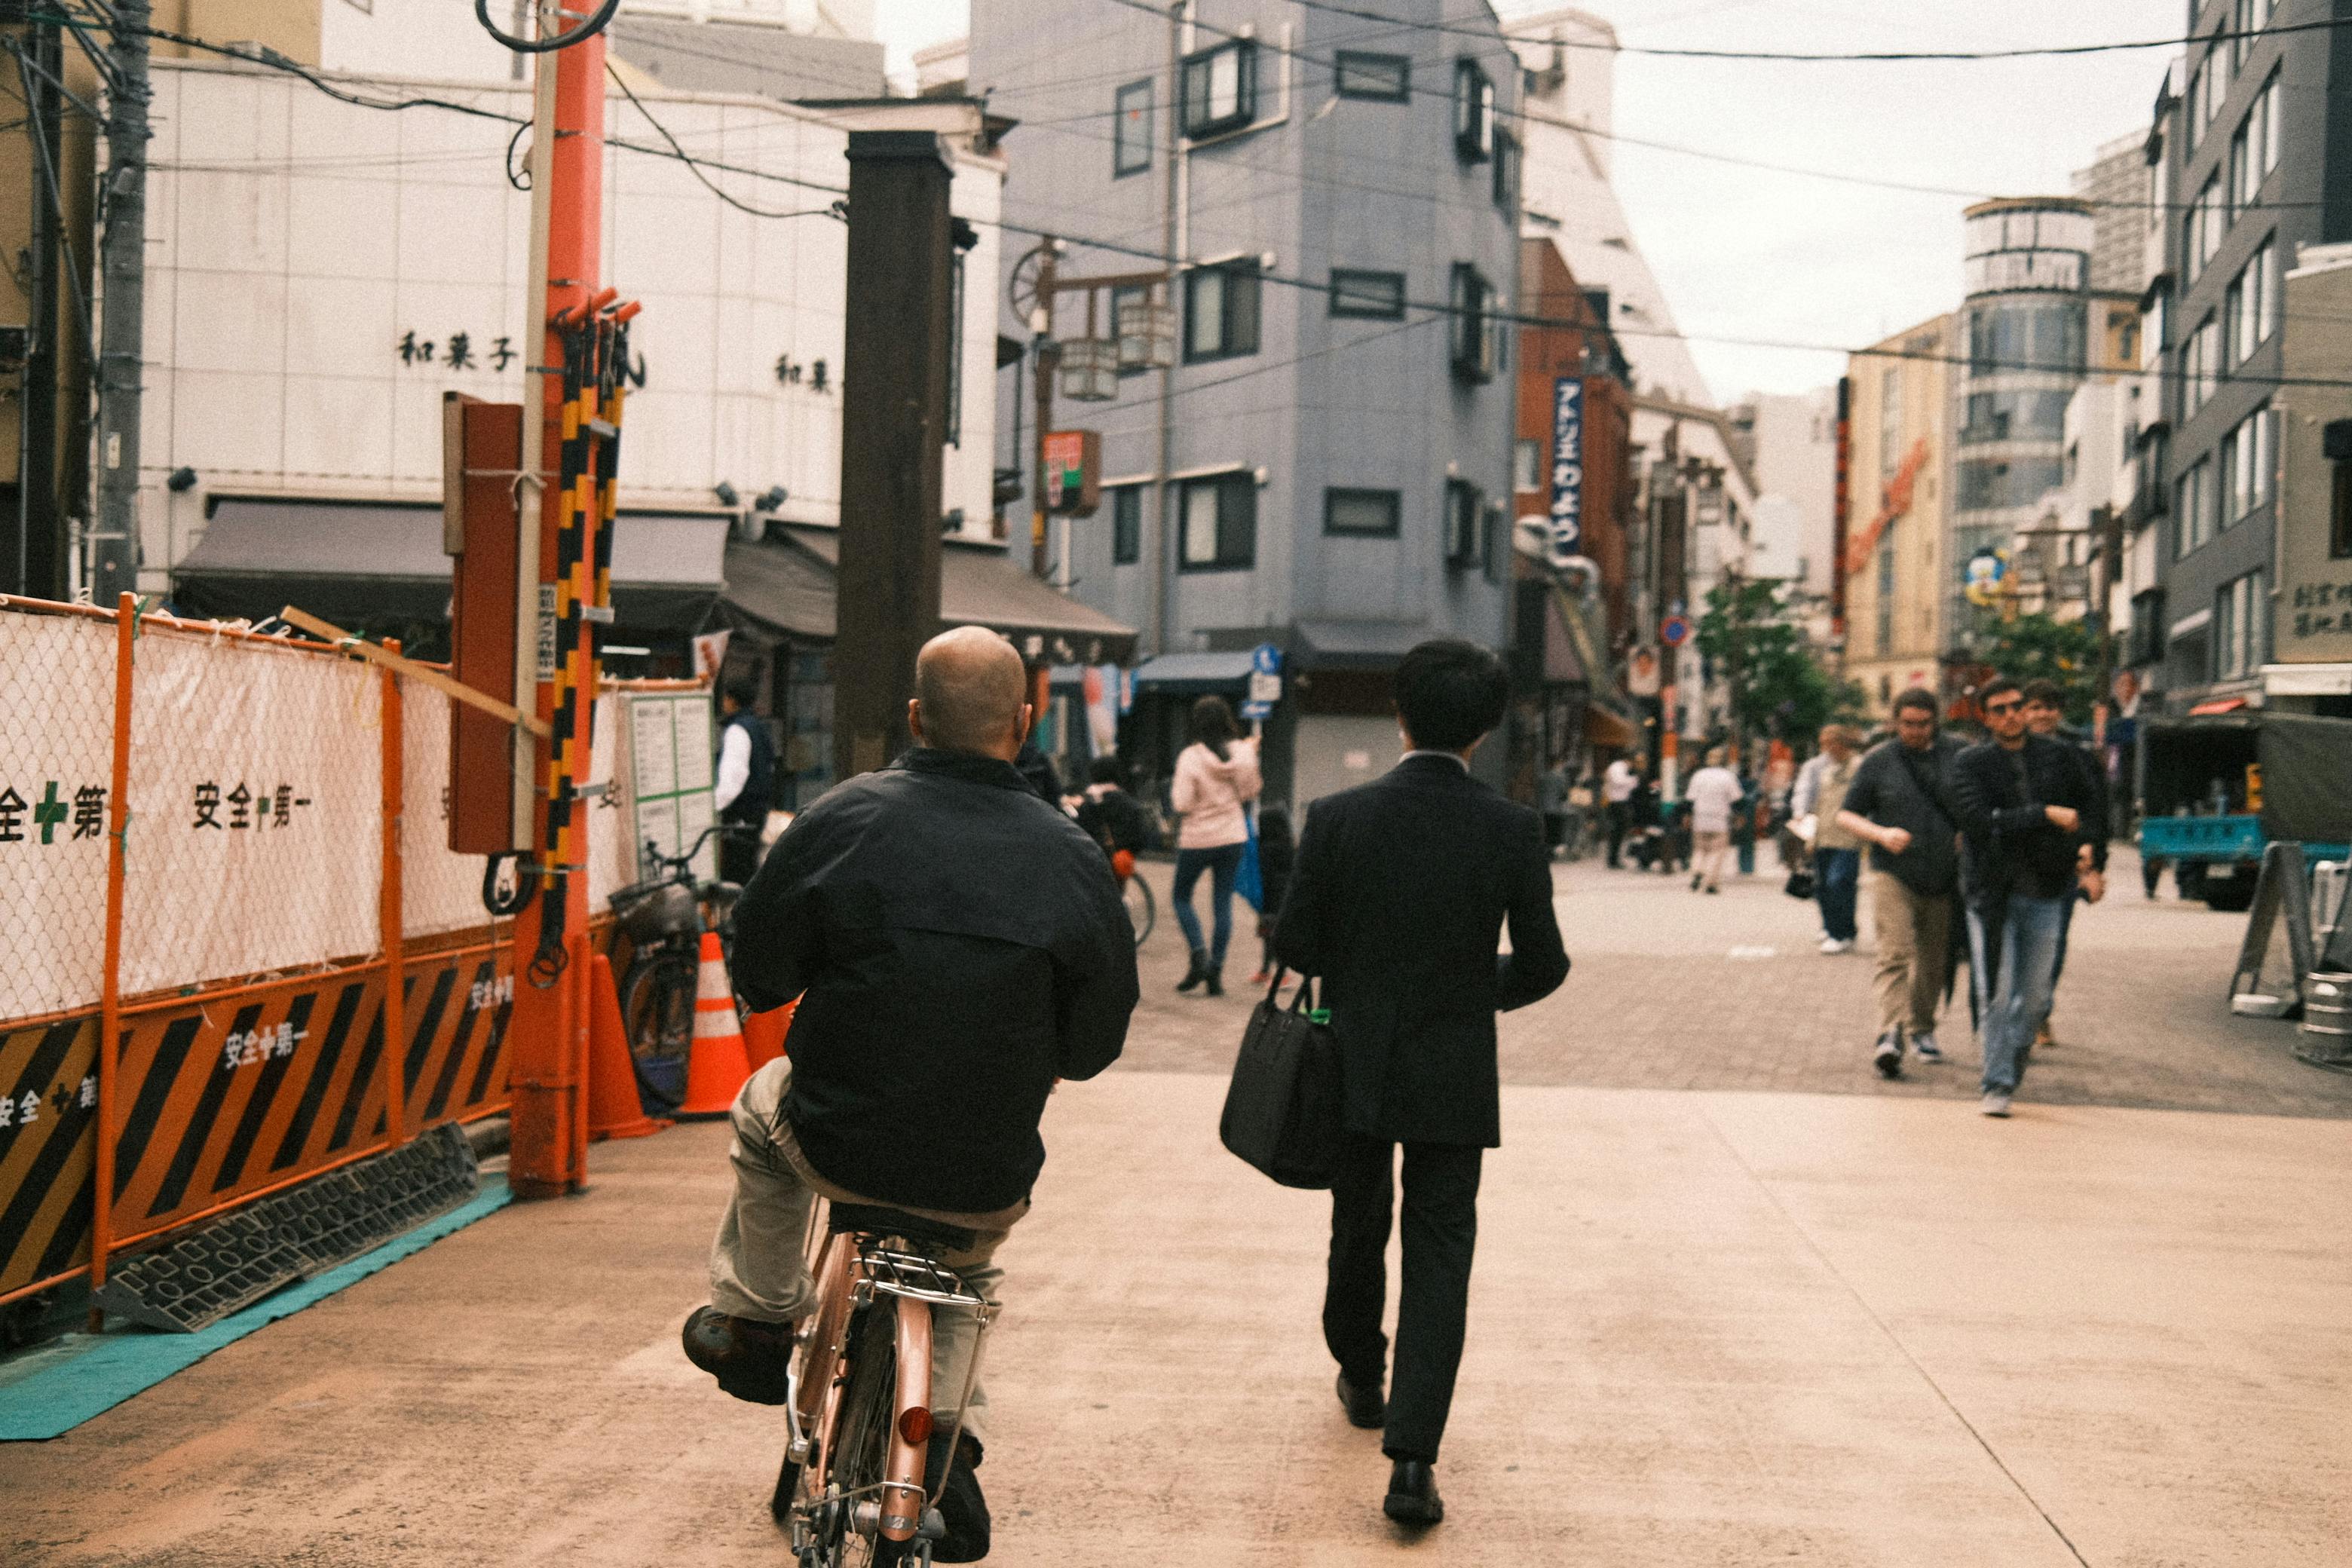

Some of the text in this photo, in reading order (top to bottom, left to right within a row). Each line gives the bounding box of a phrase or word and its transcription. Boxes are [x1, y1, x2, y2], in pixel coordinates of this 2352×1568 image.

[397, 330, 519, 372] 和菓子
[774, 353, 834, 396] 和菓
